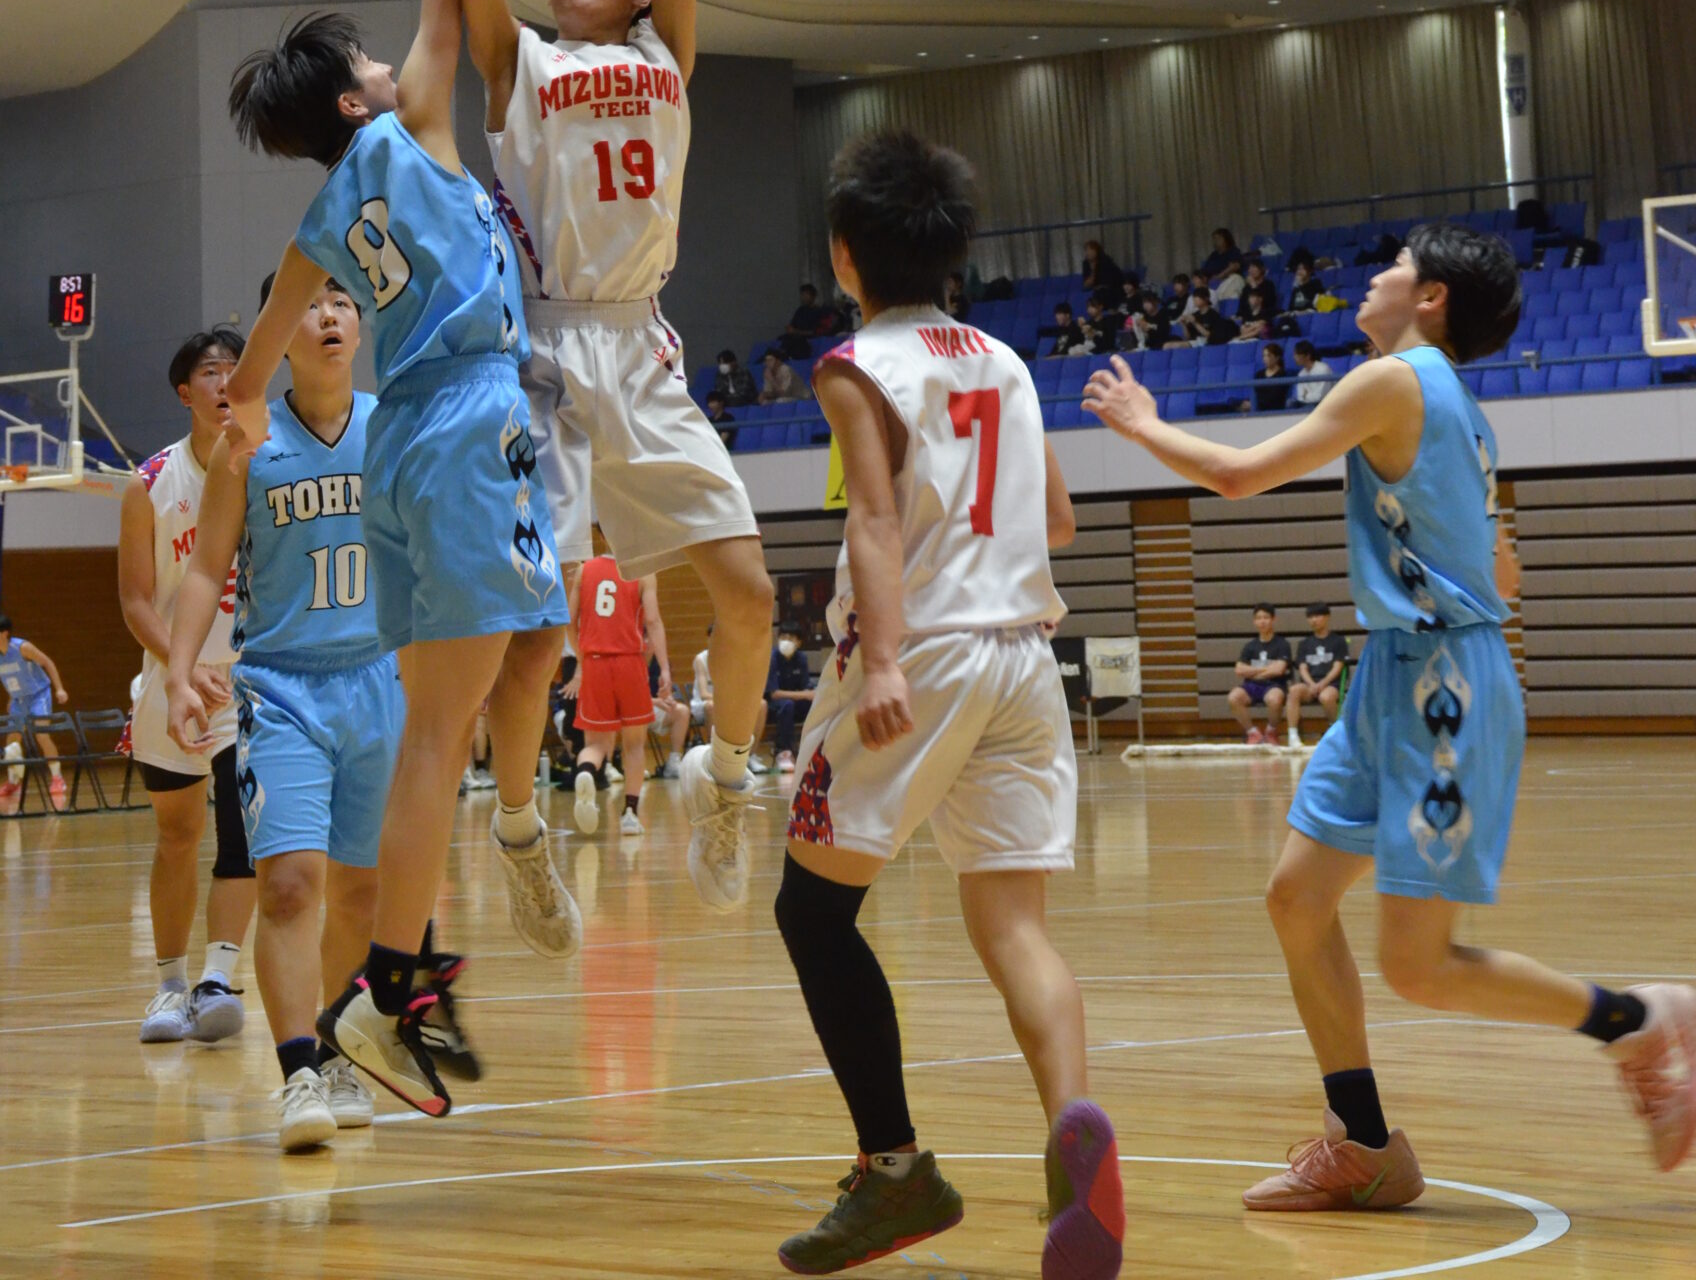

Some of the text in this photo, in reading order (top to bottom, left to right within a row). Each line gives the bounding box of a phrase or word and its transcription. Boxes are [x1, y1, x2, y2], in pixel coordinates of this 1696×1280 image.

[537, 63, 681, 120] MIZUSAWA
[590, 100, 651, 118] TECH
[593, 139, 656, 202] 19
[345, 196, 412, 312] 8
[64, 292, 84, 323] 16
[916, 326, 994, 359] IWATE
[947, 387, 1000, 537] 7
[305, 542, 368, 611] 10
[594, 579, 617, 617] 6
